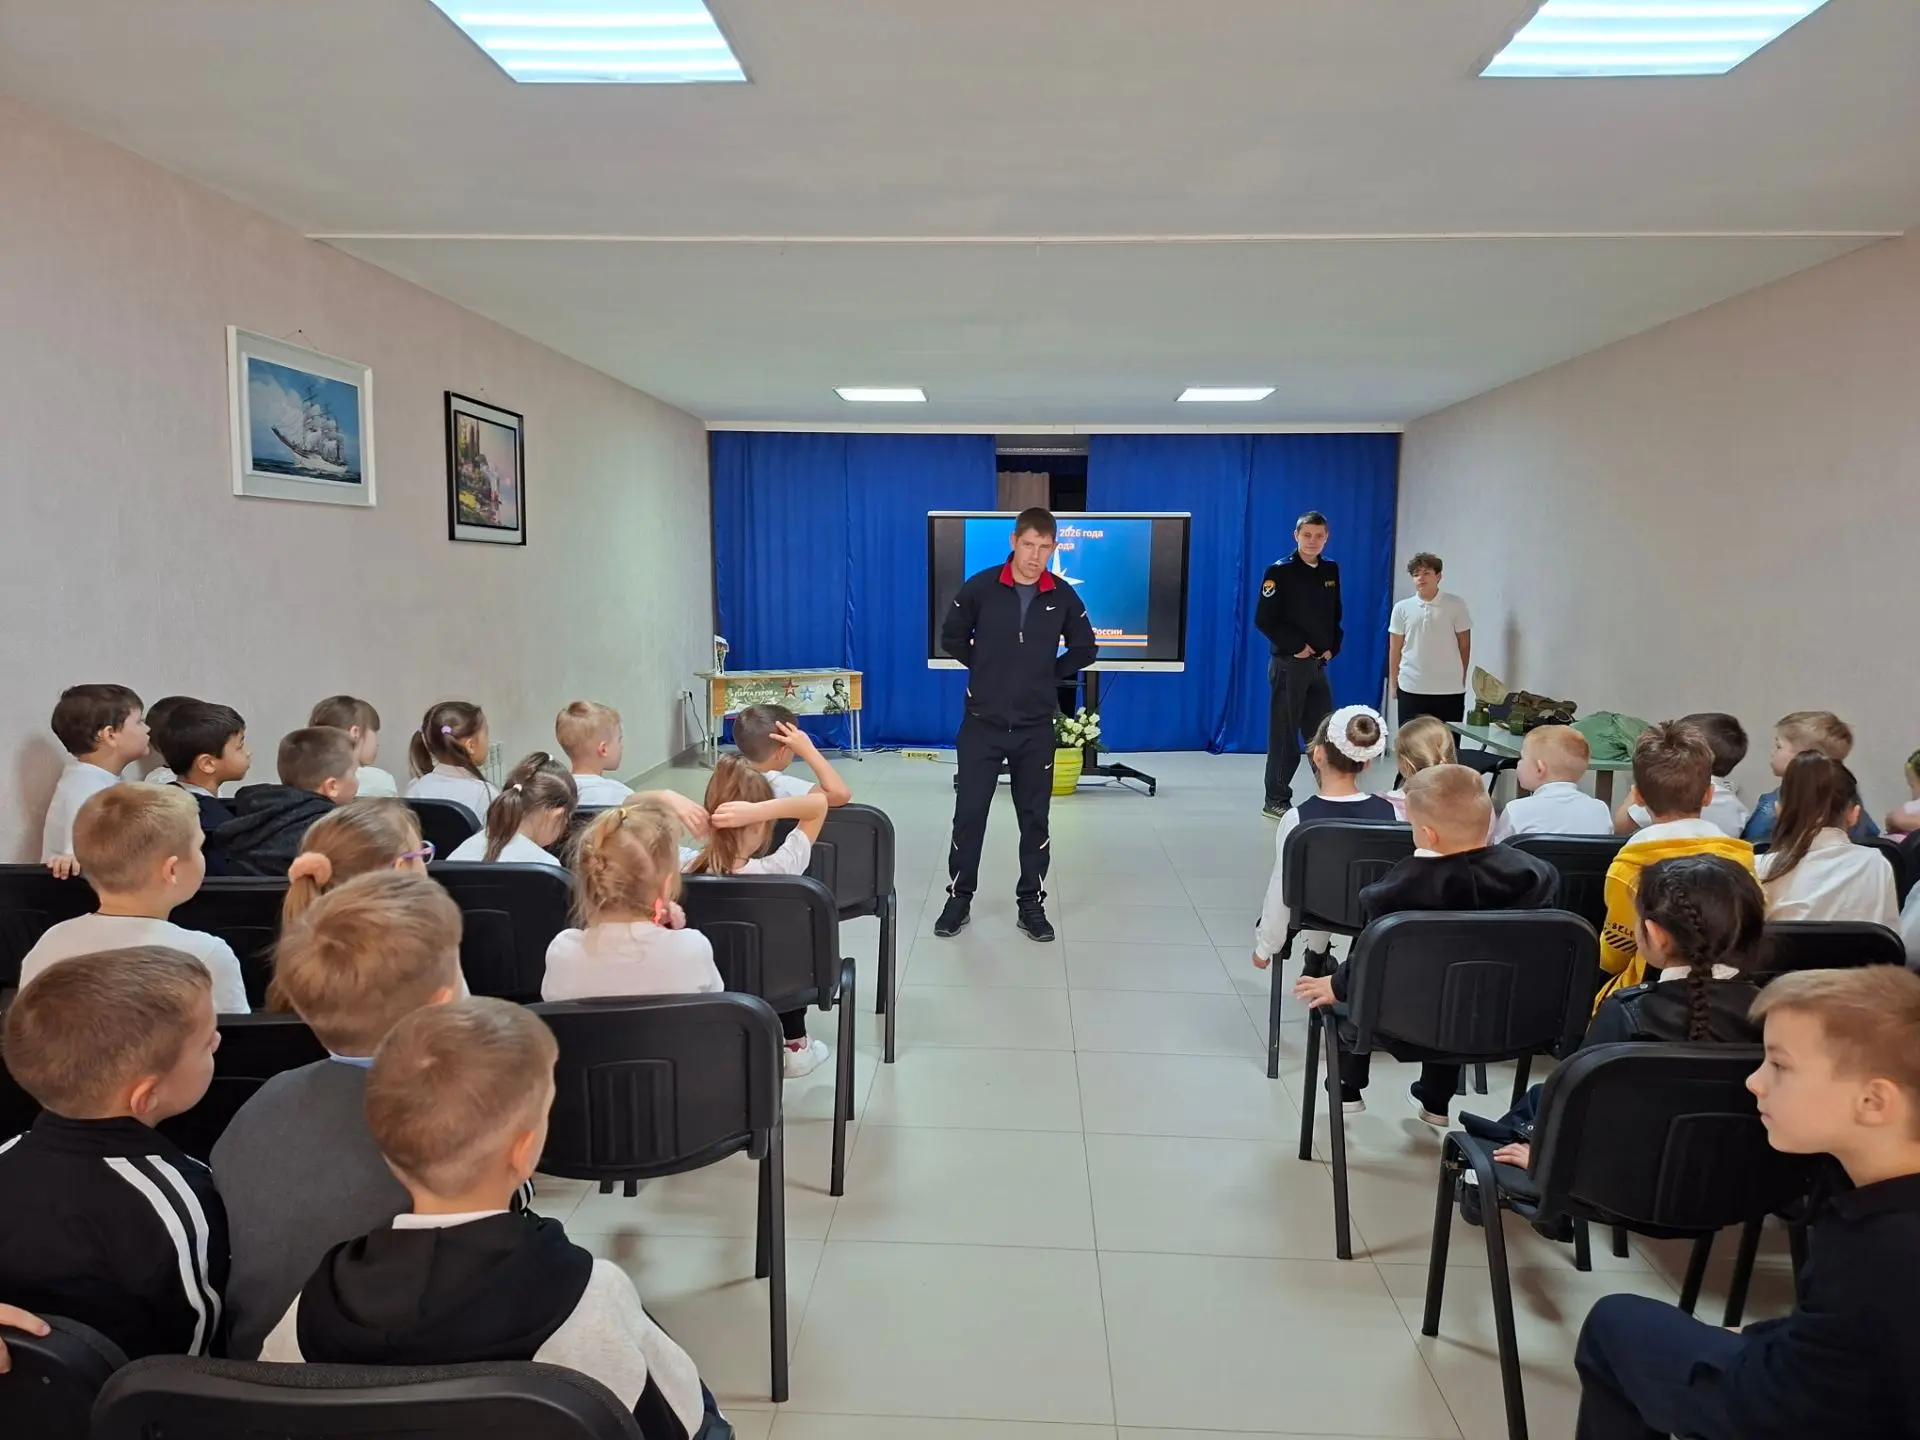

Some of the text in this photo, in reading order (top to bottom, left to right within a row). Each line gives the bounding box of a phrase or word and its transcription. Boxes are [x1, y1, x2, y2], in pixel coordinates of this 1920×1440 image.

[1059, 529, 1104, 539] 2026 года
[1057, 542, 1075, 551] ода
[1091, 627, 1123, 635] России
